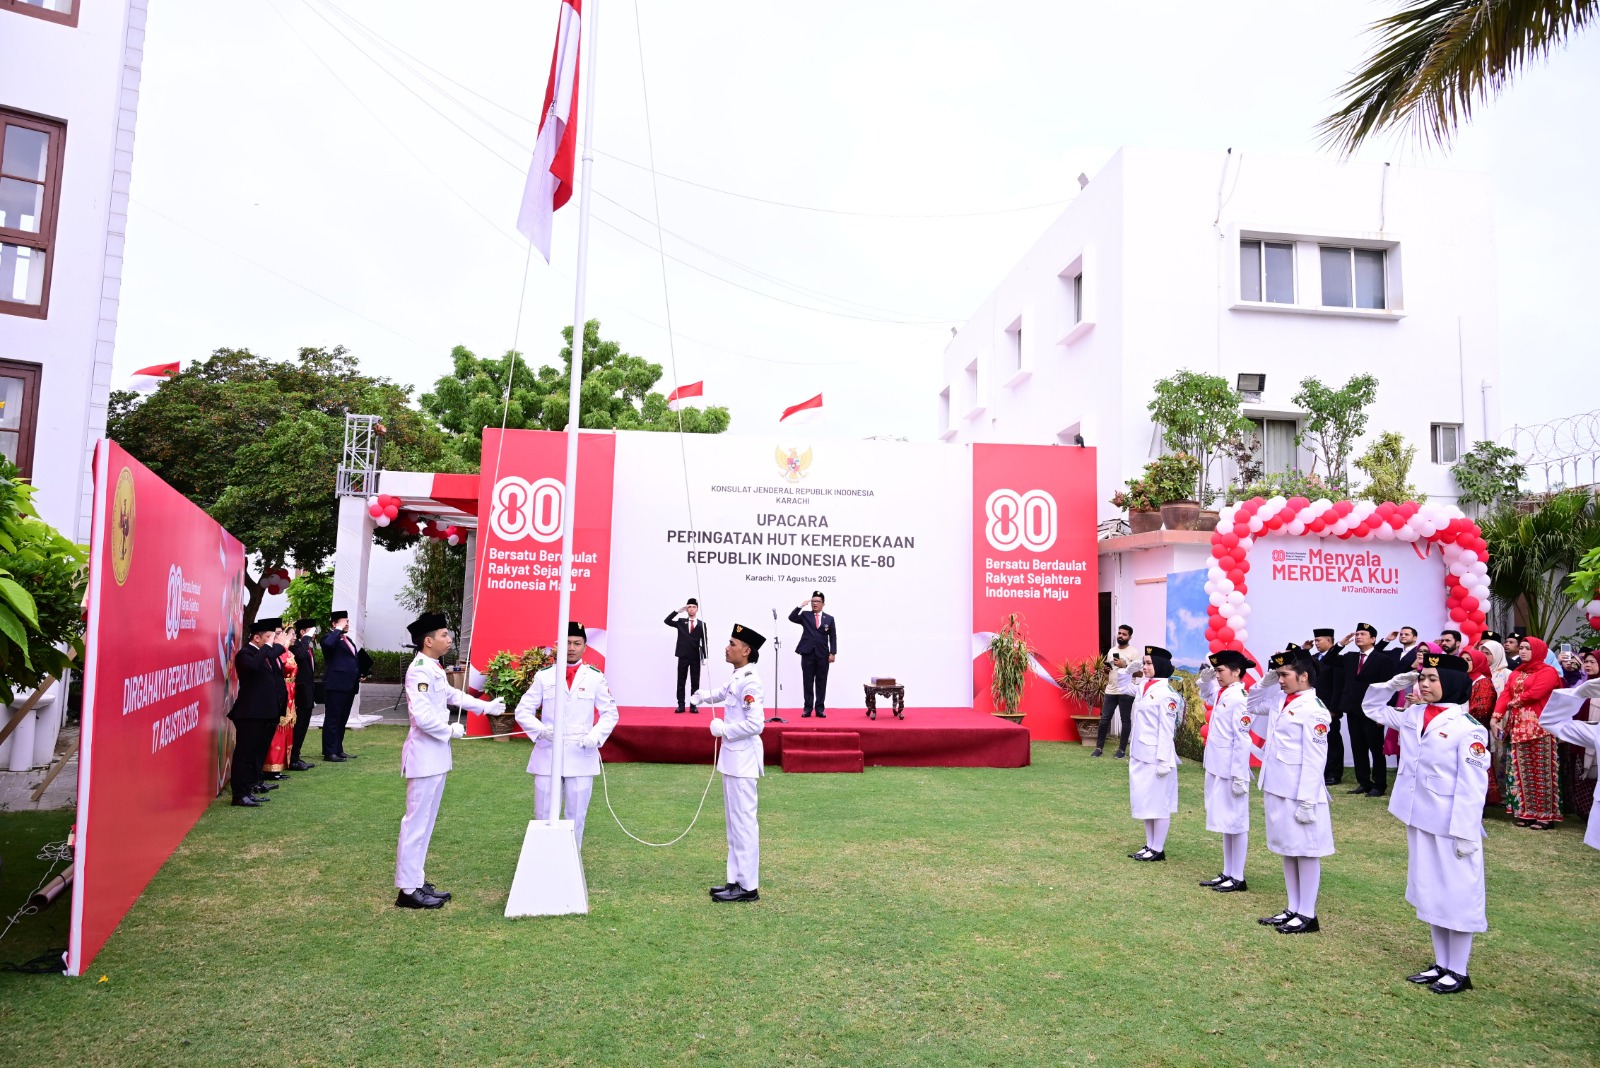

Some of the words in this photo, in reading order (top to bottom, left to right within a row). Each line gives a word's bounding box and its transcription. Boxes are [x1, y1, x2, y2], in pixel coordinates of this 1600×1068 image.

[711, 485, 751, 494] KONSULAT
[753, 486, 794, 495] JENDERAL
[796, 488, 832, 496] REPUBLIK
[834, 488, 874, 497] INDONESIA
[776, 496, 810, 505] KARACHI
[490, 475, 566, 544] 80
[756, 514, 829, 528] UPACARA
[985, 488, 1058, 553] 80
[667, 530, 763, 546] PERINGATAN
[767, 533, 797, 546] HUT
[802, 534, 915, 549] KEMERDEKAAN
[489, 548, 536, 561] Bersatu
[687, 551, 762, 565] REPUBLIK
[766, 552, 847, 567] INDONESIA
[851, 554, 896, 568] KE-80
[1308, 548, 1382, 570] Menyala
[488, 562, 530, 577] Rakyat
[986, 558, 1030, 570] Bersatu
[1032, 559, 1086, 571] Berdaulat
[778, 574, 785, 582] 17
[786, 574, 816, 584] Agustus
[986, 572, 1024, 586] Rakyat
[1027, 573, 1082, 587] Sejahtera
[1272, 564, 1362, 584] MERDEKA
[1368, 566, 1400, 585] KU!
[488, 577, 546, 591] Indonesia
[1341, 585, 1399, 595] #17anDiKarachi
[986, 586, 1040, 599] Indonesia
[1044, 587, 1069, 601] Maju
[122, 668, 167, 716] DIRGAHAYU
[168, 662, 194, 697] REPUBLIK
[152, 720, 160, 754] 17
[159, 707, 186, 750] AGUSTUS
